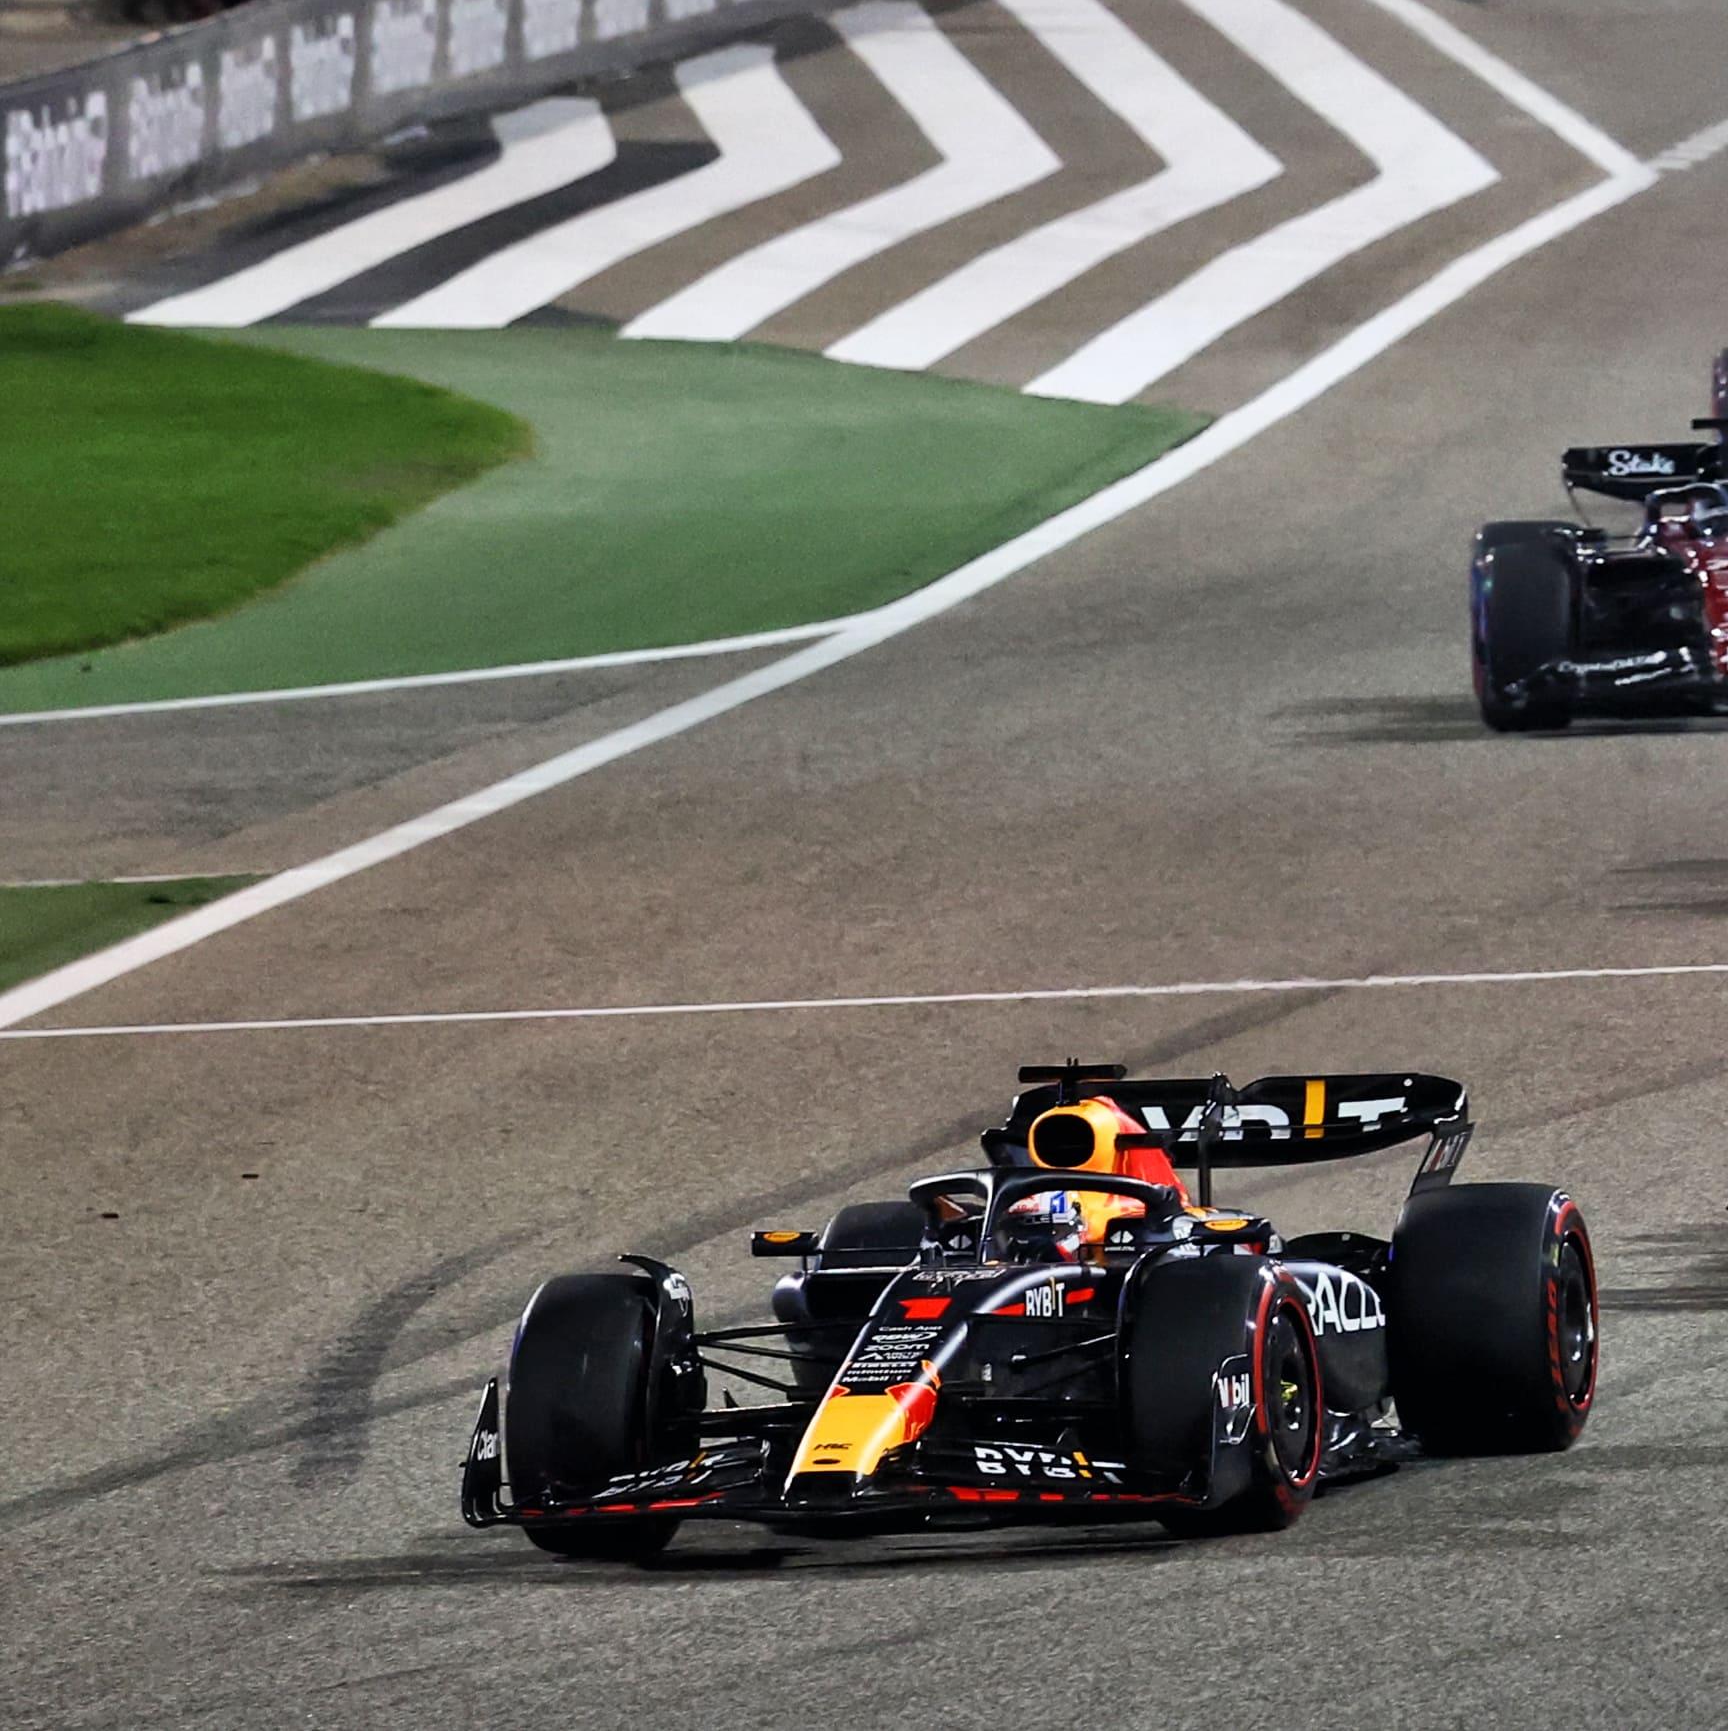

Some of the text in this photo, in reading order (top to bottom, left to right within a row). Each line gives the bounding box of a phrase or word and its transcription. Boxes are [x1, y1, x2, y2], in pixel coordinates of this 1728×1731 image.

[1607, 448, 1676, 476] Stake
[898, 1296, 952, 1319] 1
[864, 1343, 930, 1351] zoom
[842, 1375, 890, 1383] Mobil
[477, 1429, 498, 1461] Clar
